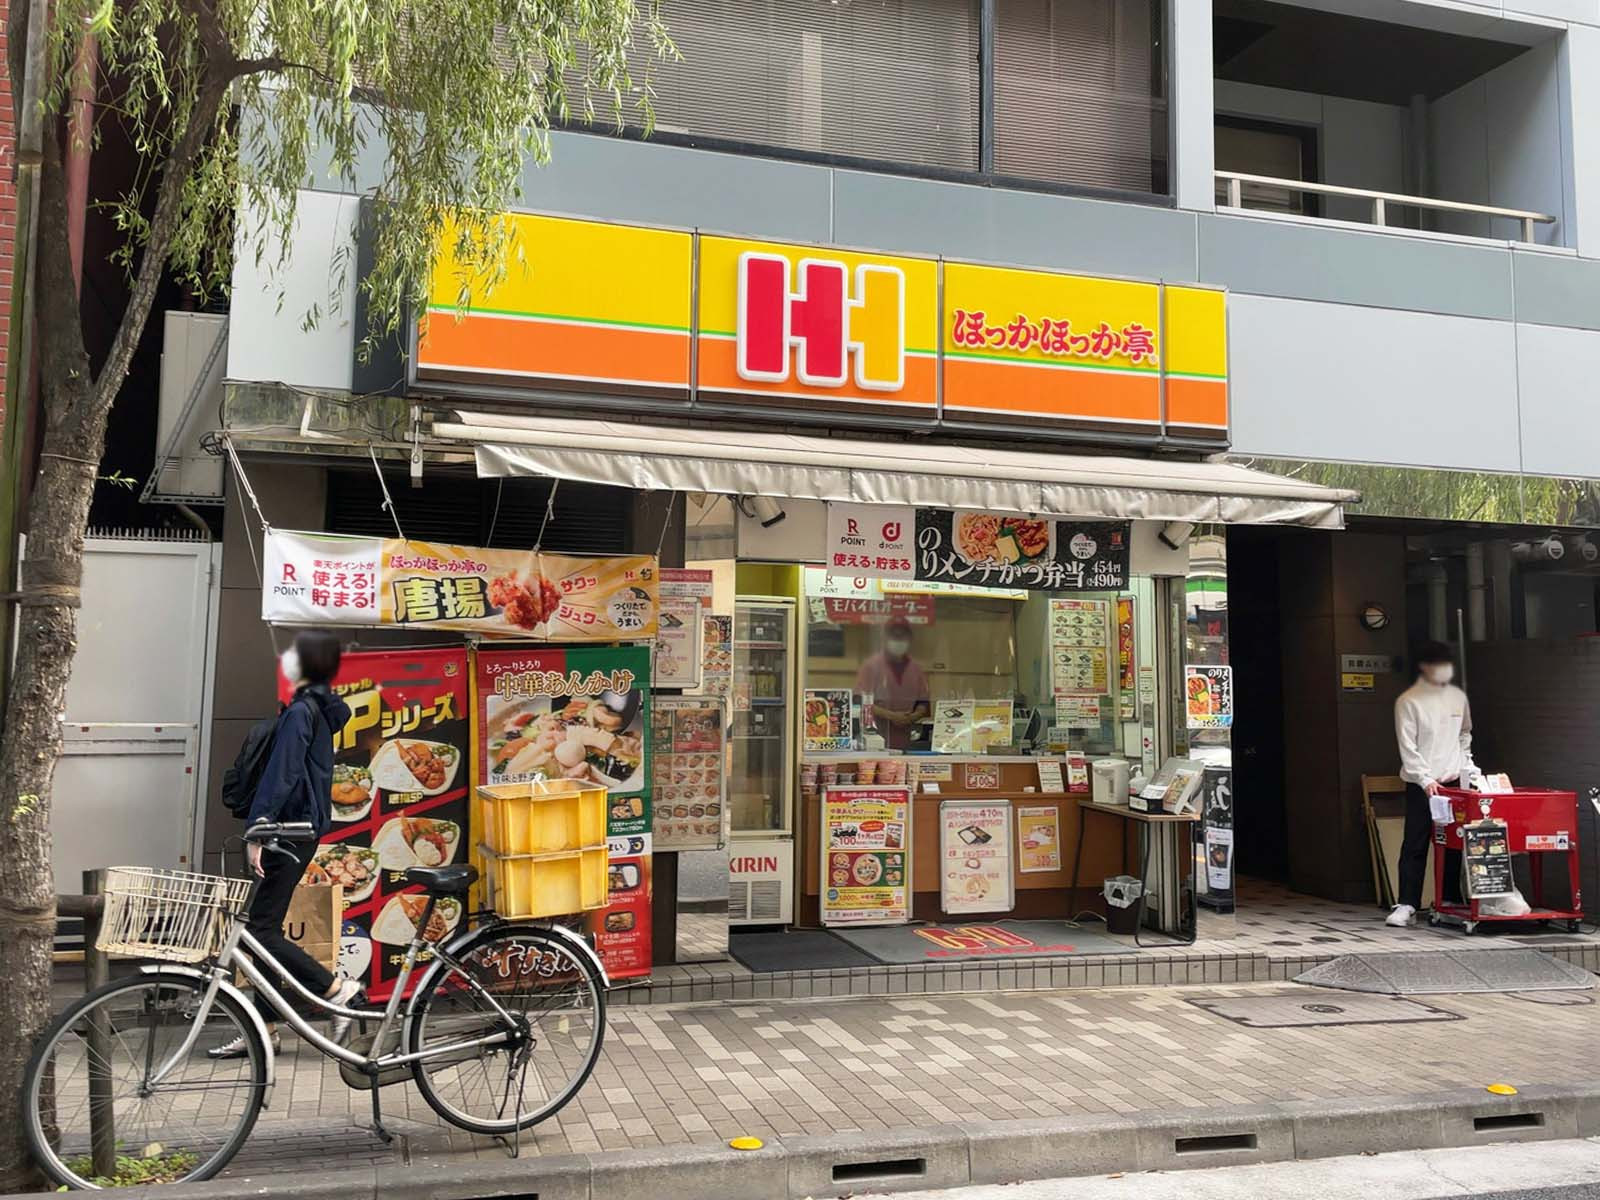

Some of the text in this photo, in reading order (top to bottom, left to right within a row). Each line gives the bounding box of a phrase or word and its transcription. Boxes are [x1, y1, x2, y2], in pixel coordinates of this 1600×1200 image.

[953, 309, 1154, 362] ほっかほっか亭
[848, 519, 859, 533] R
[841, 537, 866, 546] POINT
[283, 563, 297, 582] R
[391, 555, 487, 573] ほっかほっか亭の
[312, 571, 375, 590] 使える!
[273, 586, 305, 596] POINT
[312, 589, 375, 608] 貯まる!
[393, 577, 488, 623] 唐揚
[494, 668, 635, 701] 中華あんかけ
